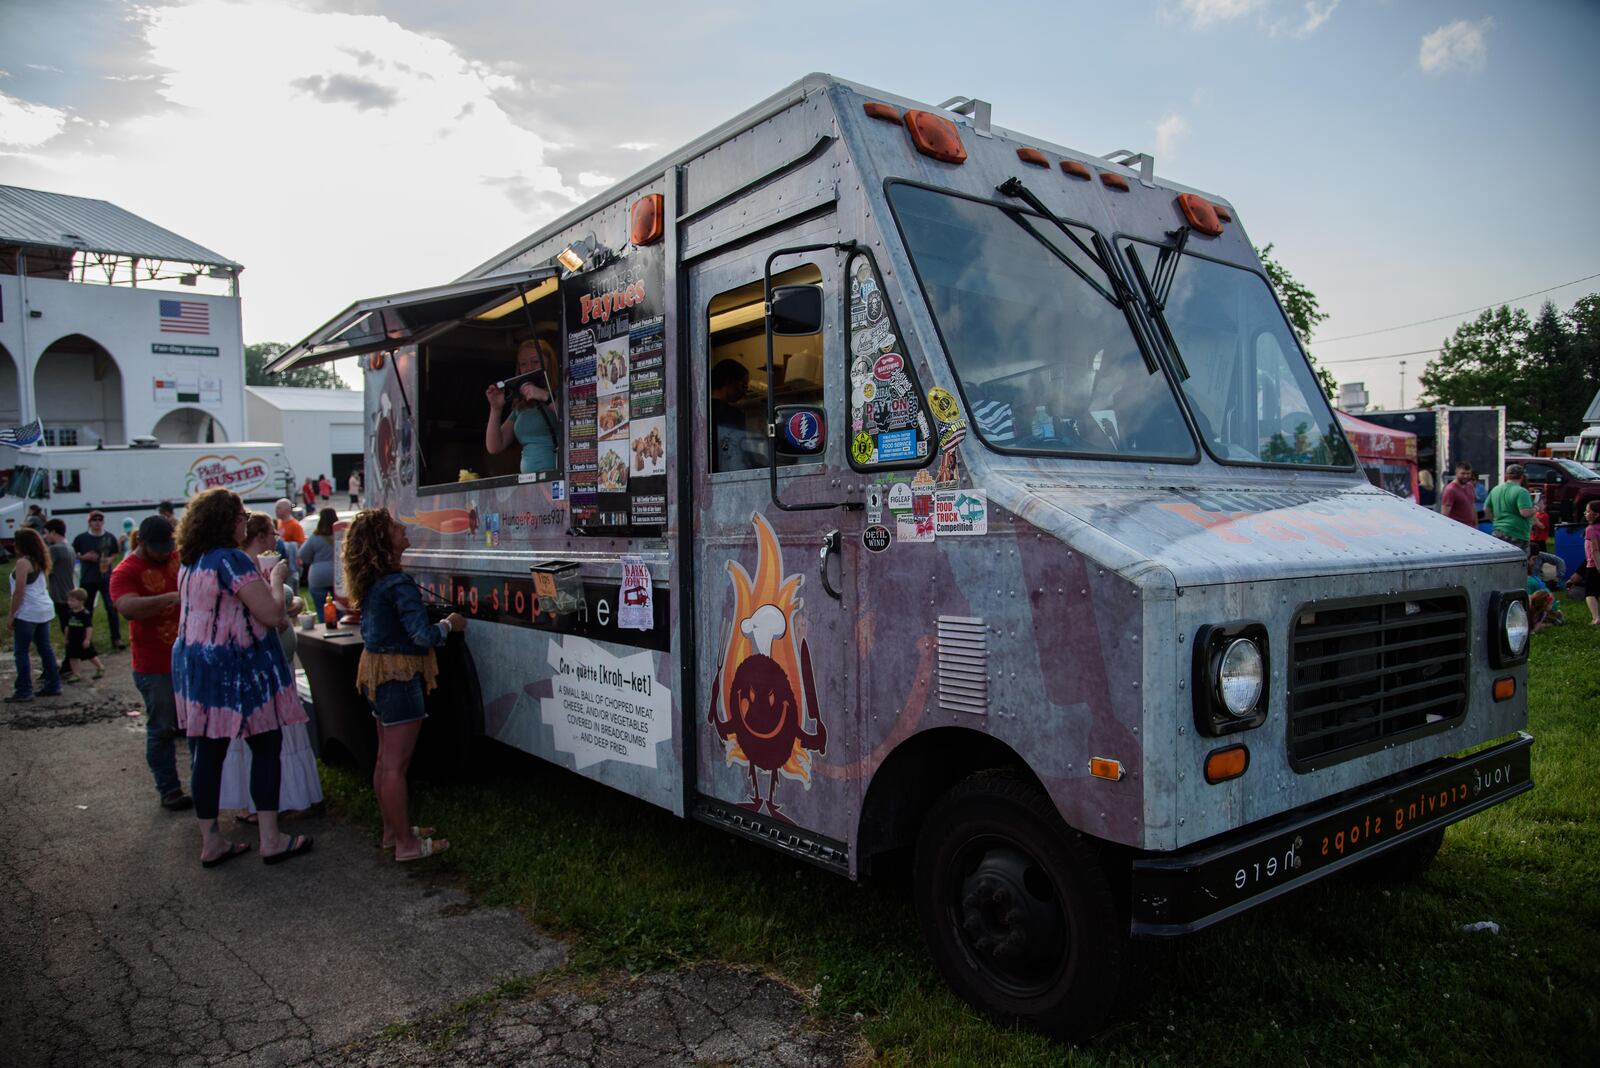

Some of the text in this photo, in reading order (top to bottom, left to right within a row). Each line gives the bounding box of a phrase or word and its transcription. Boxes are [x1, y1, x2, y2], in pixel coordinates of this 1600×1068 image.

[579, 279, 646, 325] Paynes
[866, 399, 908, 414] DAYTON
[206, 466, 264, 488] BUSTER
[890, 495, 910, 504] FIGLEAF
[936, 503, 953, 513] FOOD
[936, 513, 958, 524] TRUCK
[865, 530, 888, 541] DEVIL
[936, 523, 973, 535] Competition
[868, 538, 885, 549] WIND
[492, 582, 556, 625] stop
[563, 686, 580, 699] SMALL
[581, 690, 594, 703] BALL
[595, 694, 603, 704] OF
[605, 697, 634, 714] CHOPPED
[567, 713, 647, 748] COVERED IN BREADCRUMBS
[610, 713, 649, 734] VEGETABLES
[581, 732, 593, 744] AND
[594, 736, 609, 749] DEEP
